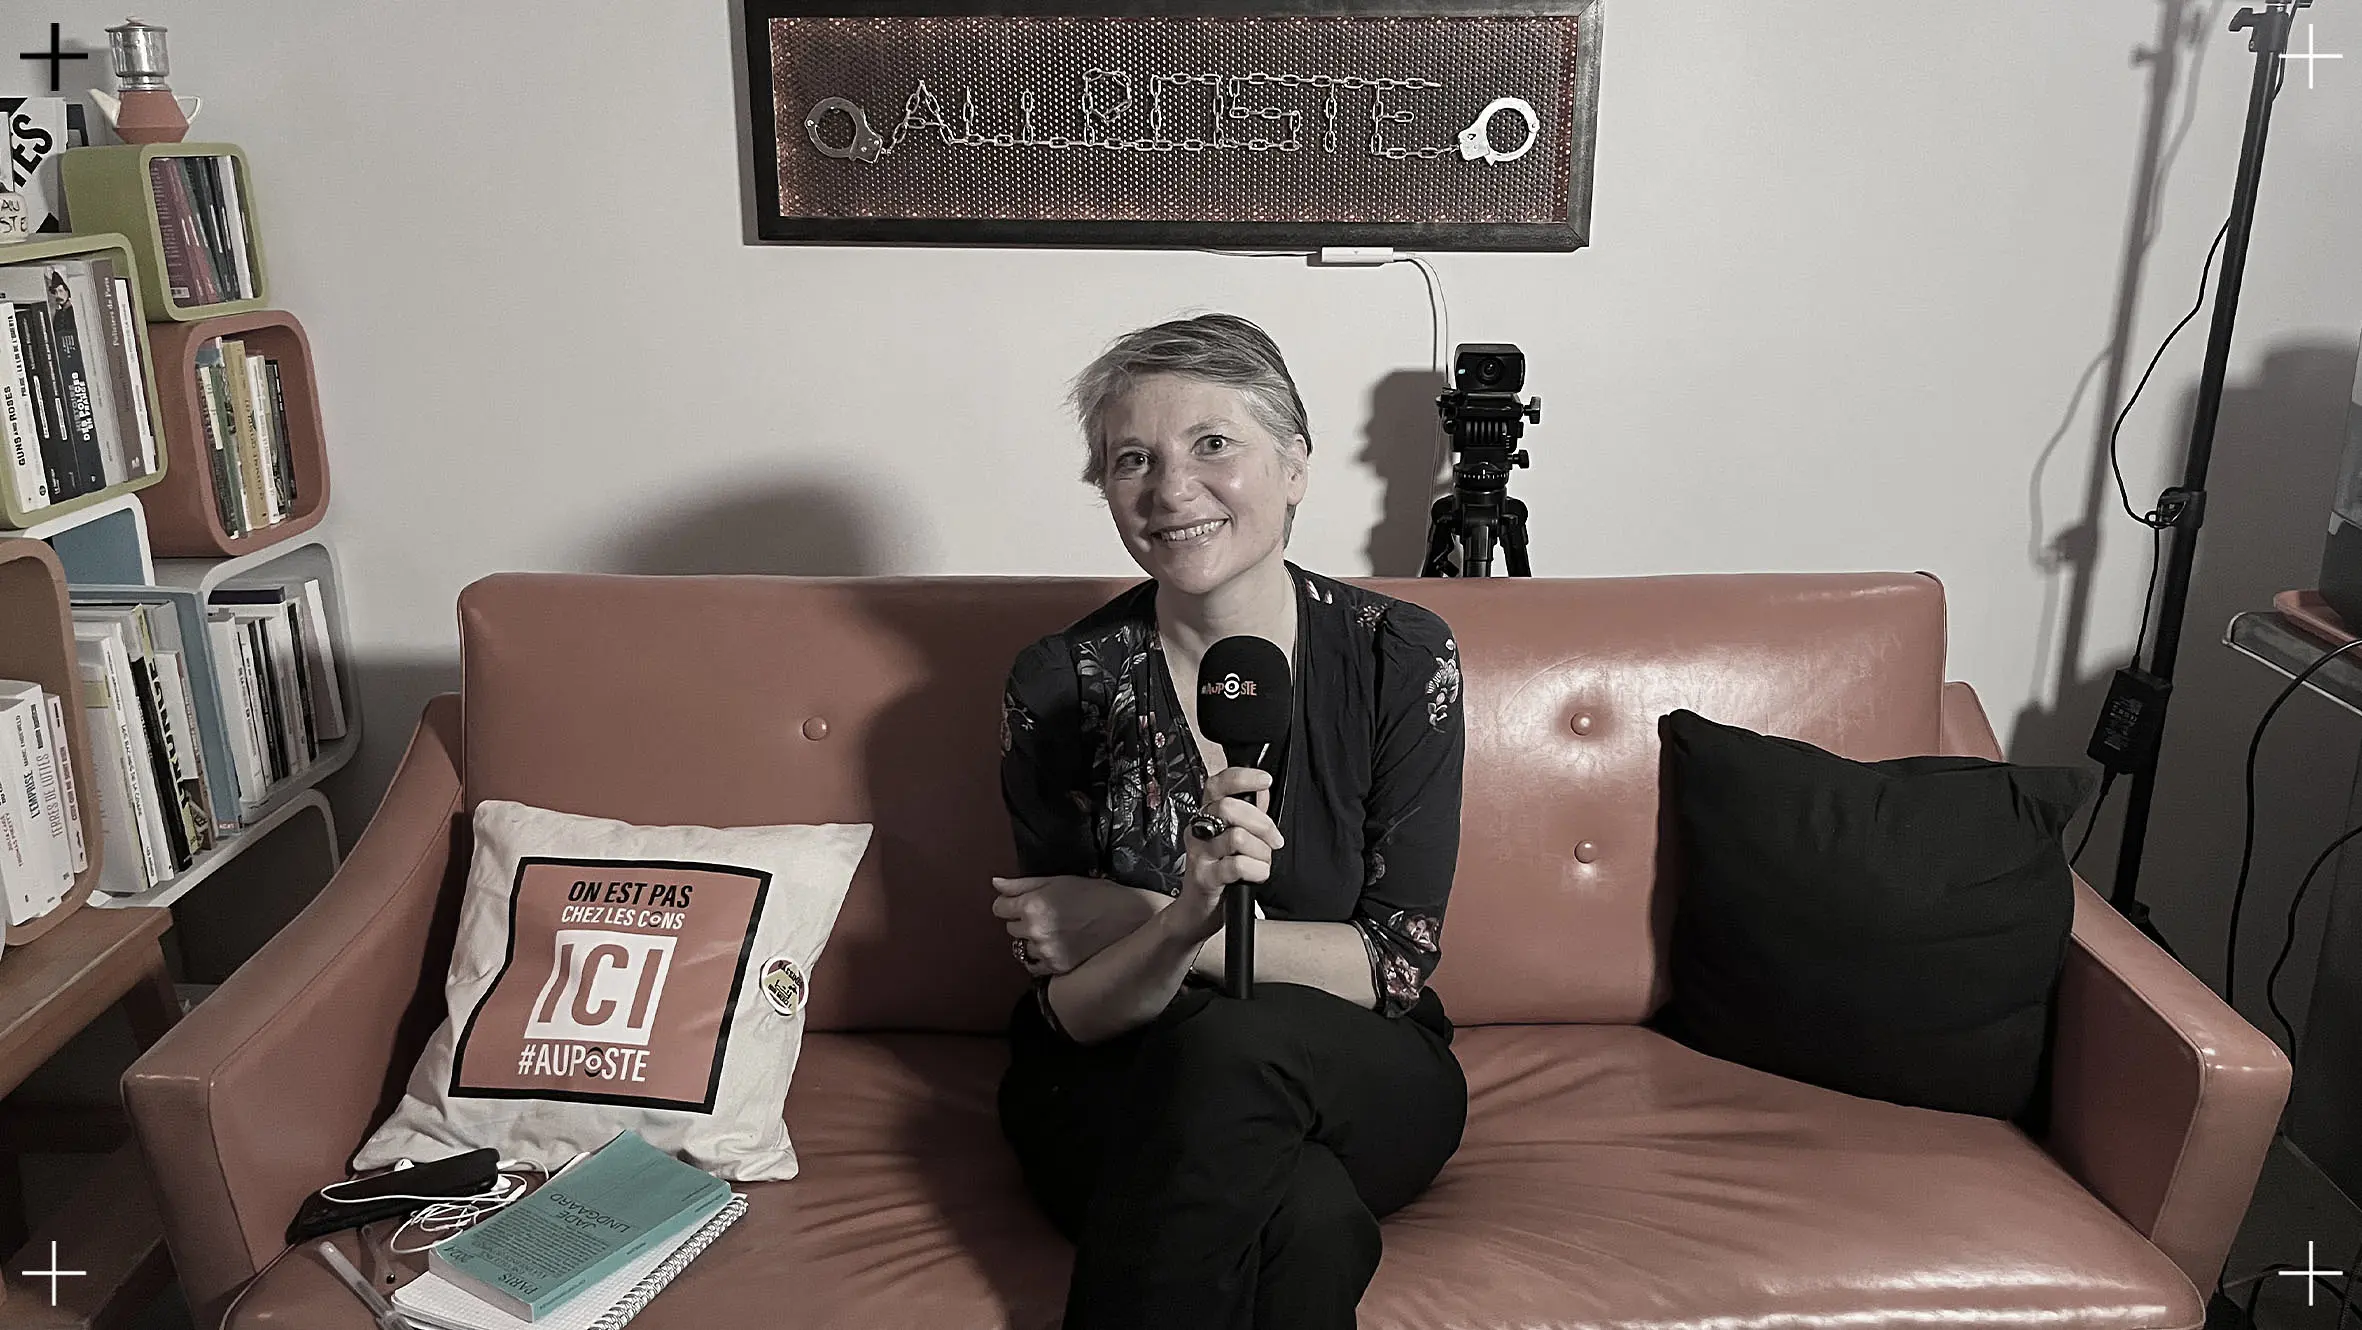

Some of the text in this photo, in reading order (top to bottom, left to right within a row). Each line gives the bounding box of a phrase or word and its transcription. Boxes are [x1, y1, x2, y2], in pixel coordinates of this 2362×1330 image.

[4, 386, 17, 421] ROSES
[14, 437, 26, 466] GUNS
[23, 770, 41, 819] L'EMPRISE
[36, 753, 63, 838] TERRES DE LUTTES
[567, 880, 693, 909] ON EST PAS
[561, 906, 686, 930] CHEZ LES CONS
[537, 942, 665, 1030] ICI
[518, 1043, 651, 1082] #AUPOSTE
[549, 1192, 631, 1233] LINDGAARD
[554, 1210, 597, 1230] JADE
[497, 1273, 539, 1296] PARIS
